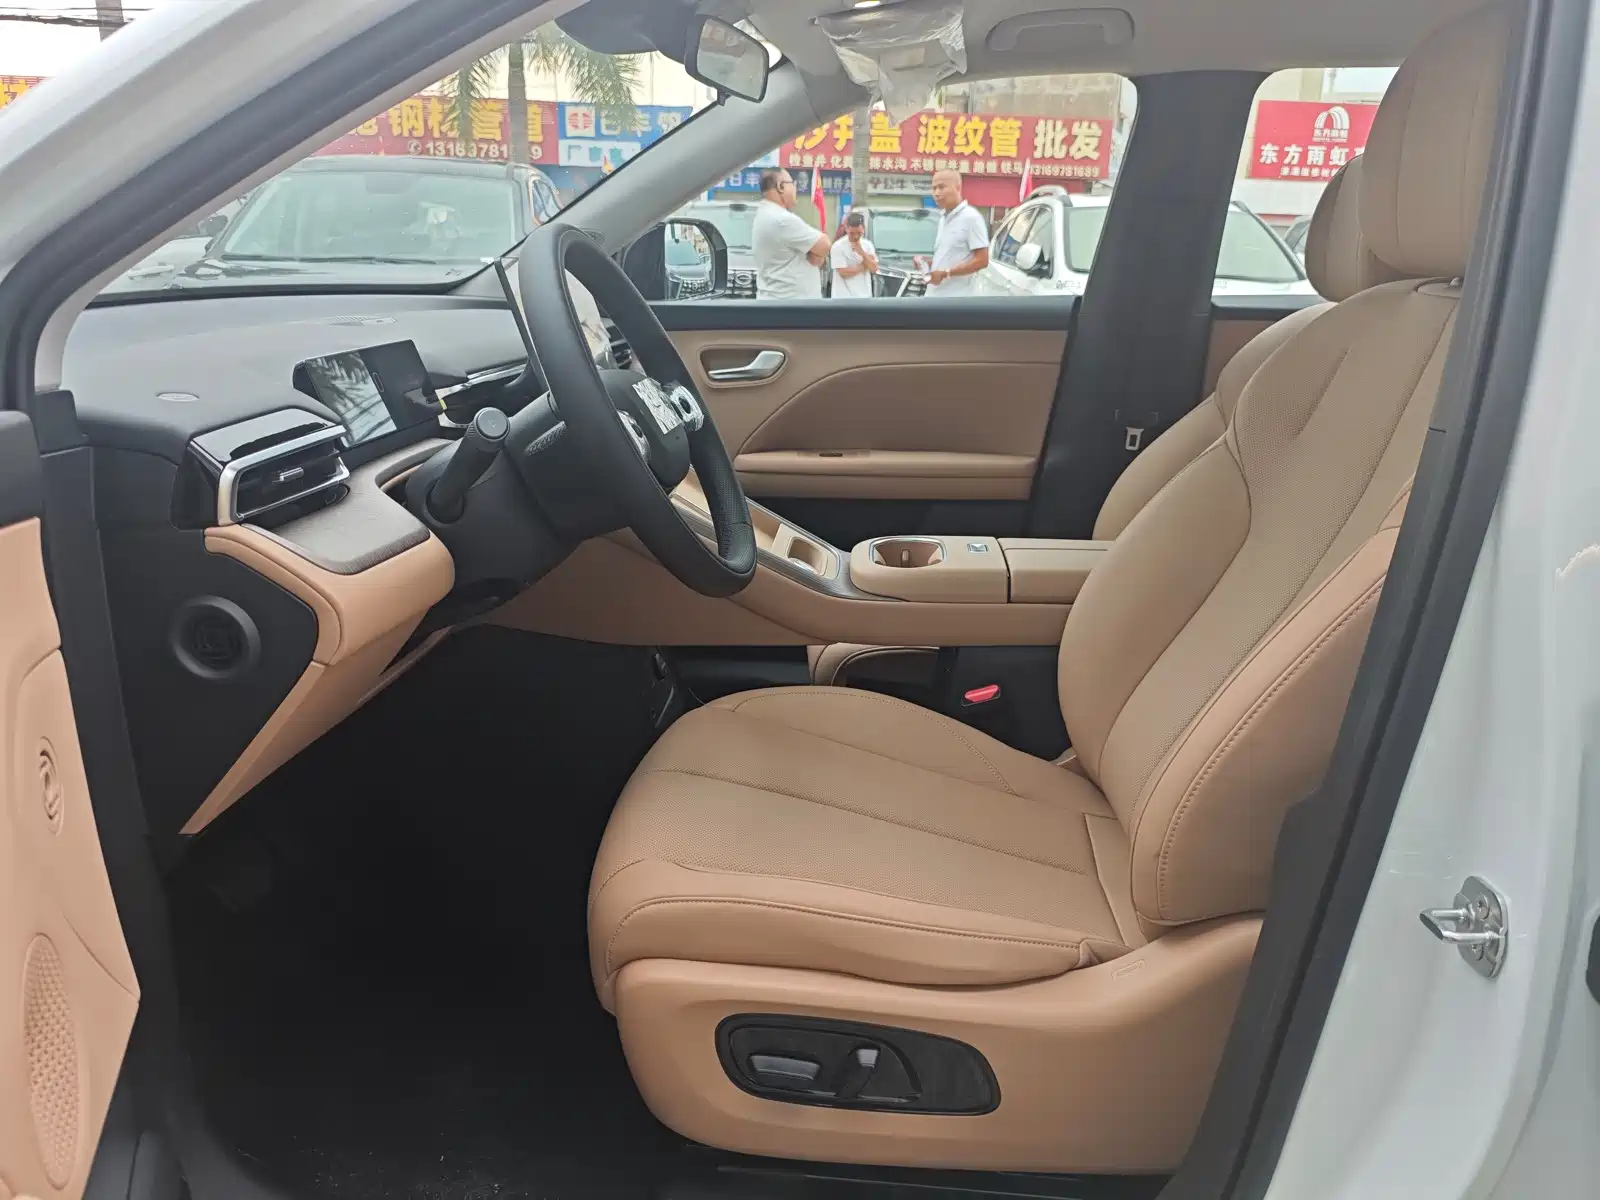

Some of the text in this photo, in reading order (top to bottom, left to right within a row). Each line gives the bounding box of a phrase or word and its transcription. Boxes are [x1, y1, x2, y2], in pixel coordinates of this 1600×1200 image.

[425, 139, 543, 160] 131697819
[918, 115, 1023, 158] 波纹管
[1034, 119, 1102, 160] 批发
